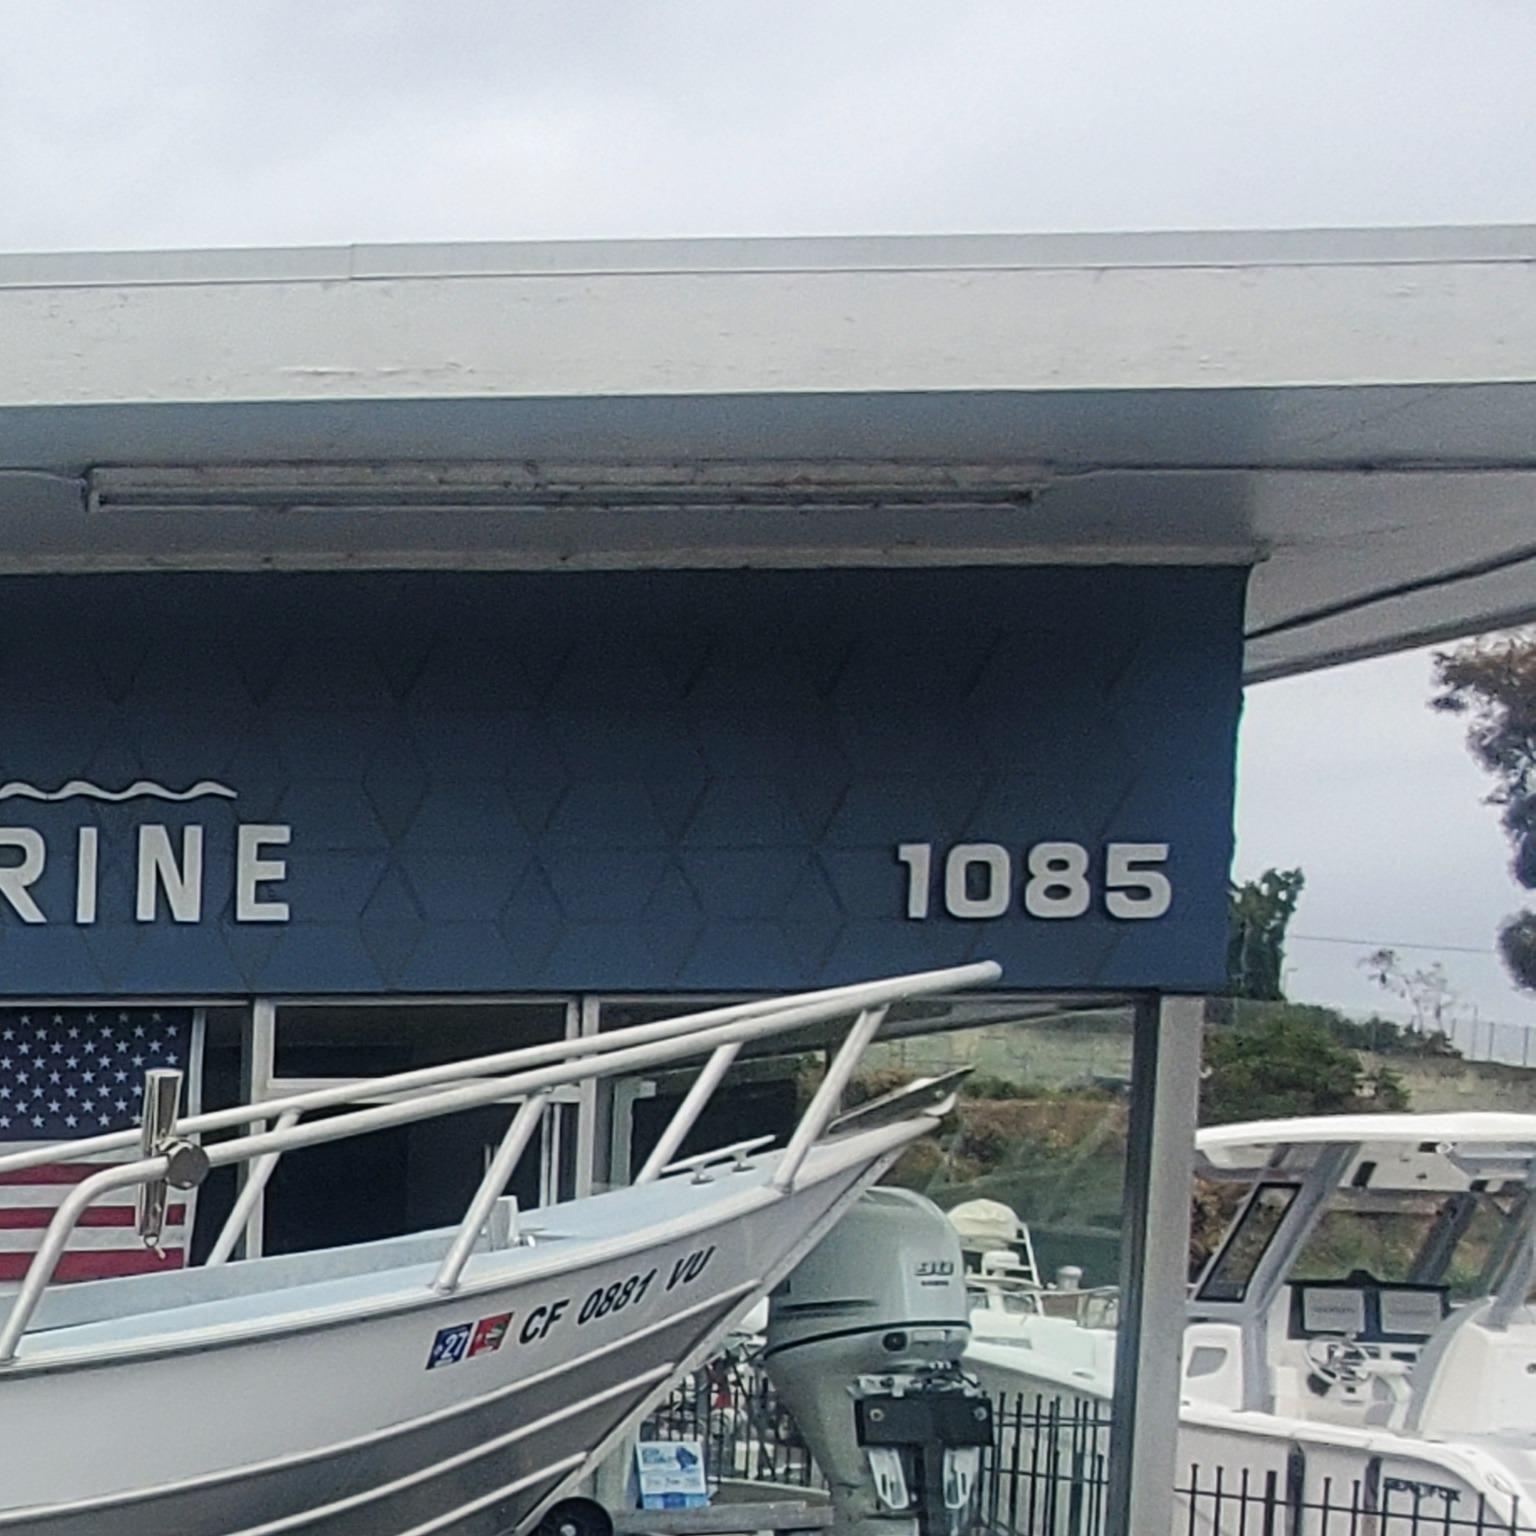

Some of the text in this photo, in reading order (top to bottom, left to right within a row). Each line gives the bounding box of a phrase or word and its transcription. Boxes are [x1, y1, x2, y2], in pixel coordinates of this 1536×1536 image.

[898, 841, 1172, 919] 1085
[519, 1246, 716, 1345] CF 0881 VU
[440, 1330, 469, 1359] 27
